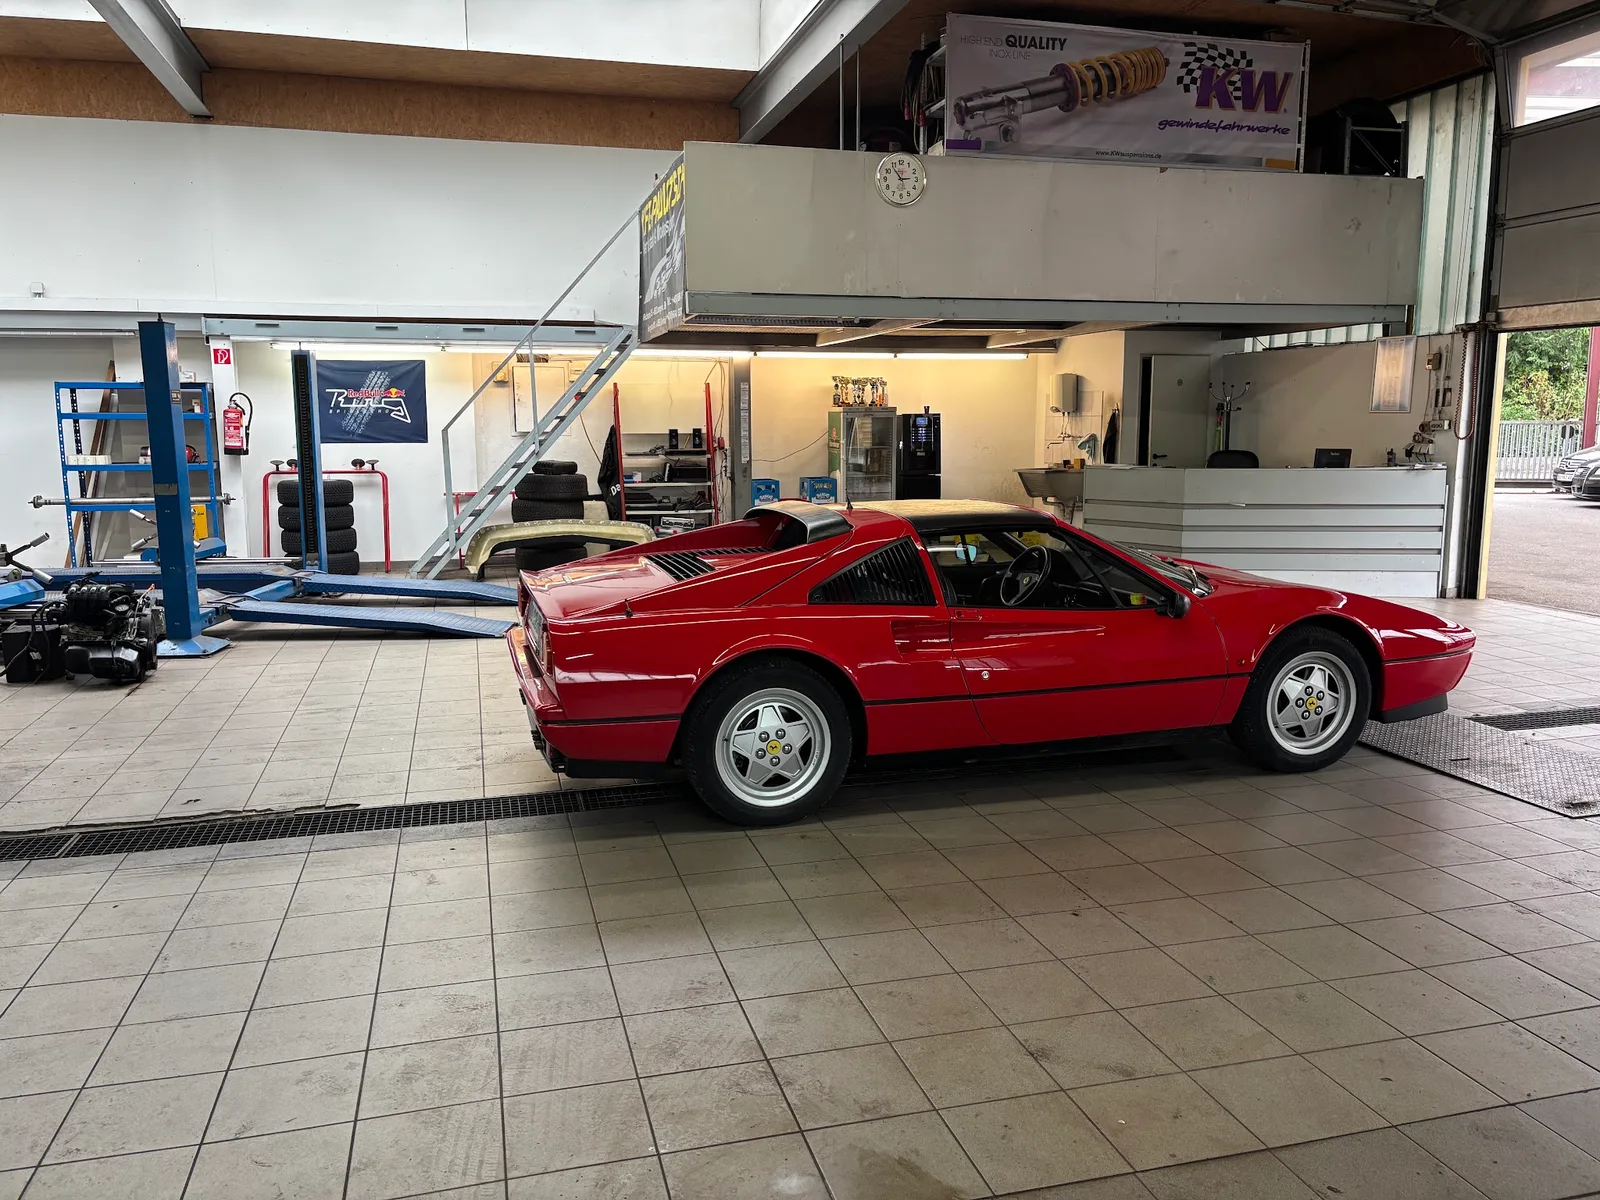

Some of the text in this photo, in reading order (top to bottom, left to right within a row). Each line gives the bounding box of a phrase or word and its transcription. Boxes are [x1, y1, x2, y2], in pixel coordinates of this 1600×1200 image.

[960, 34, 1068, 51] HIGH END QUALITY
[1195, 66, 1294, 114] KW
[1157, 118, 1291, 135] gewindefahrwerke
[347, 389, 380, 398] Red Bull
